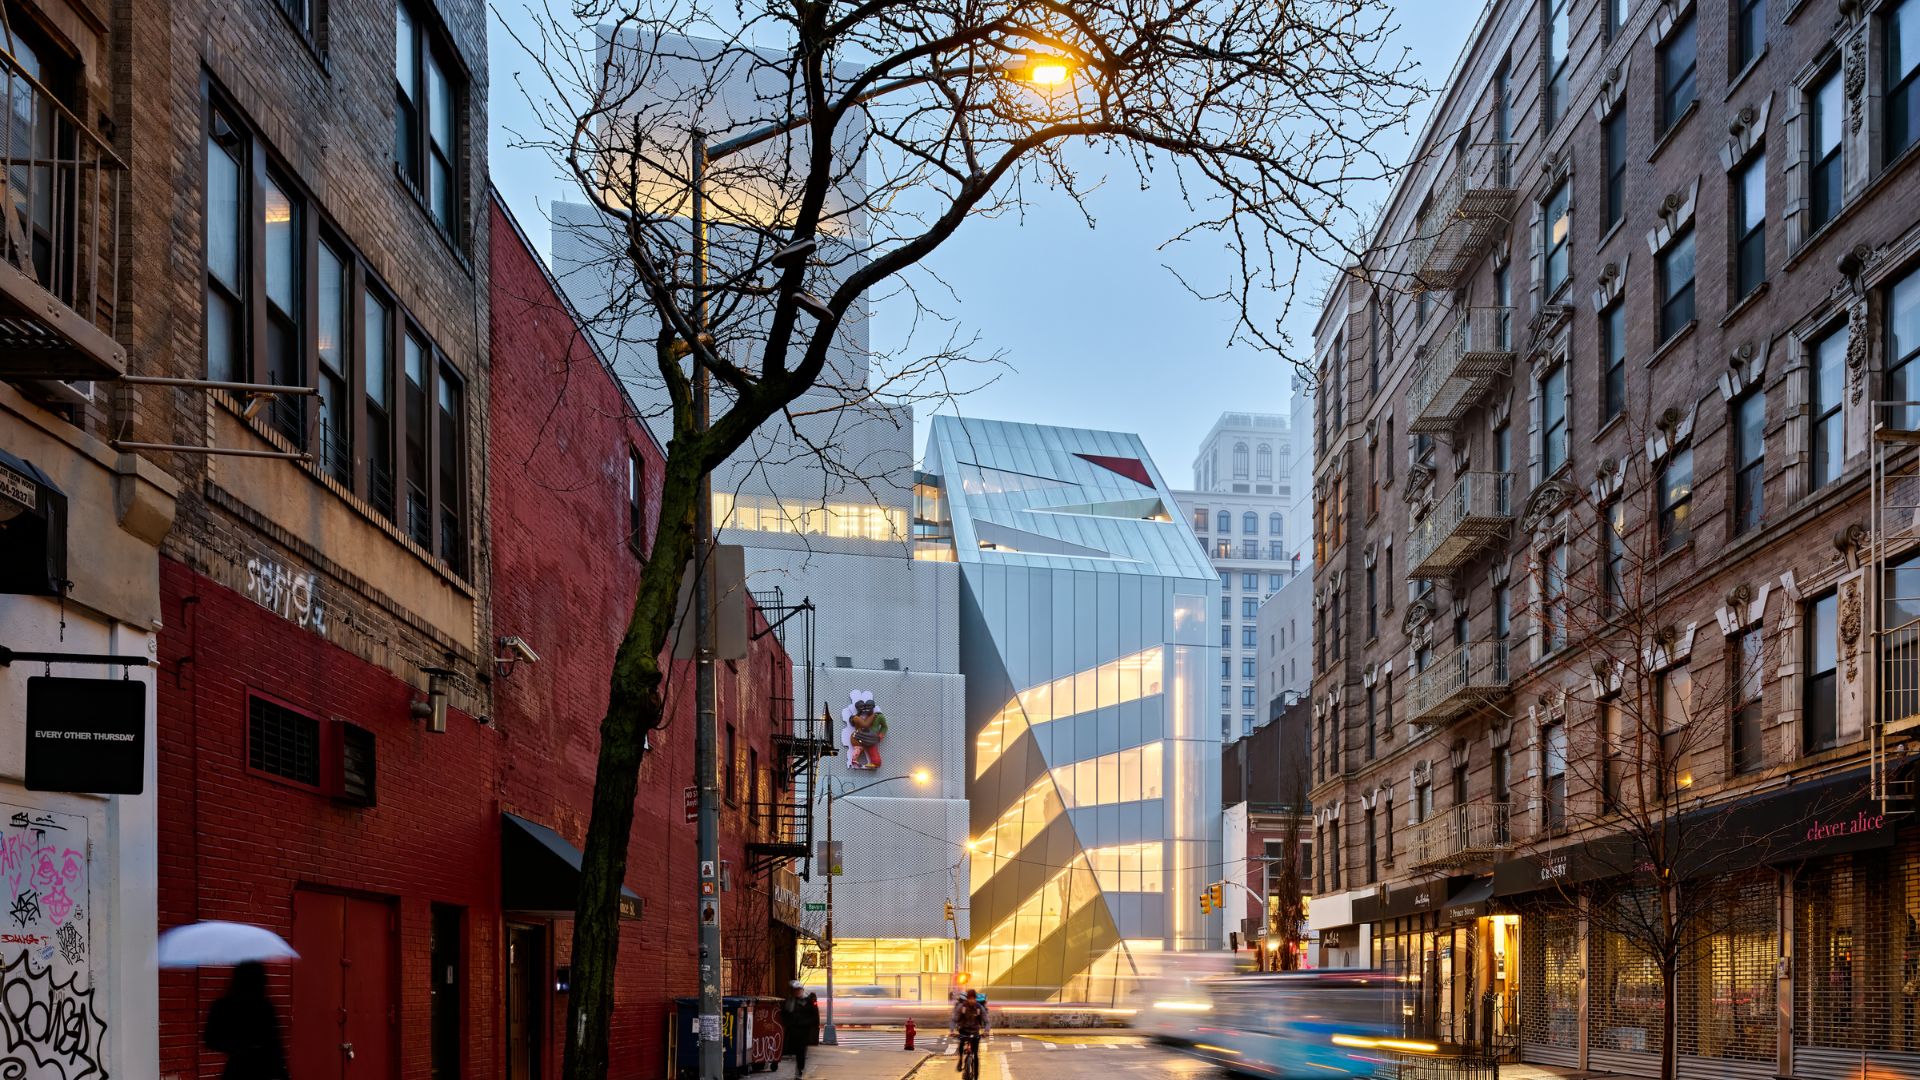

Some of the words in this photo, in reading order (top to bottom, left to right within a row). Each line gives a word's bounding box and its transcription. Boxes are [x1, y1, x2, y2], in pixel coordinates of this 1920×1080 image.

[9, 472, 20, 484] IRON
[21, 478, 35, 491] WORK
[0, 480, 28, 503] 04-2837
[35, 730, 63, 739] EVERY
[64, 731, 91, 740] OTHER
[93, 732, 135, 741] THURSDAY
[685, 791, 693, 799] NO
[1807, 820, 1846, 841] clever
[1850, 808, 1884, 833] alice
